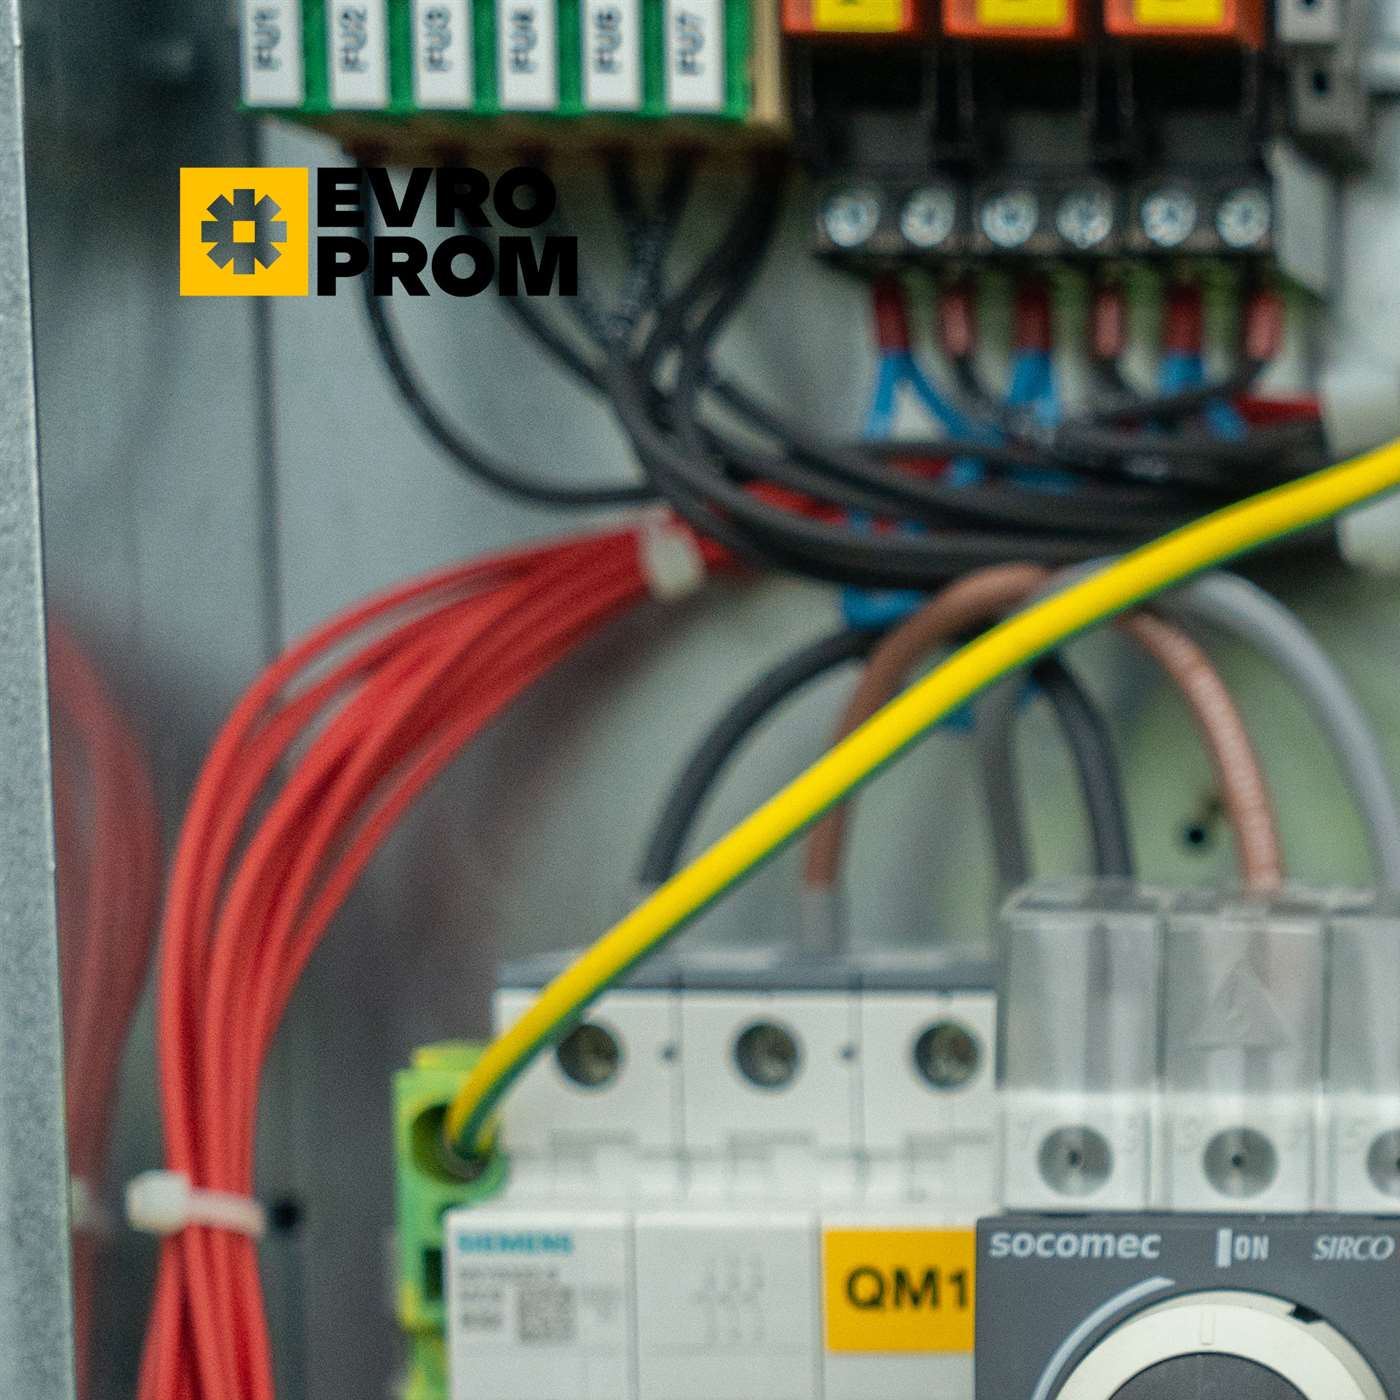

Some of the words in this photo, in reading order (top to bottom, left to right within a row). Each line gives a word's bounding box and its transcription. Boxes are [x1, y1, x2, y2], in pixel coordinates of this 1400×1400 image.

[253, 8, 281, 72] FU1
[340, 7, 369, 73] FU2
[425, 7, 451, 72] FU3
[991, 1231, 1161, 1259] socomec
[1235, 1236, 1269, 1261] ON
[1314, 1235, 1395, 1261] SIRCO
[847, 1267, 967, 1310] QM1
